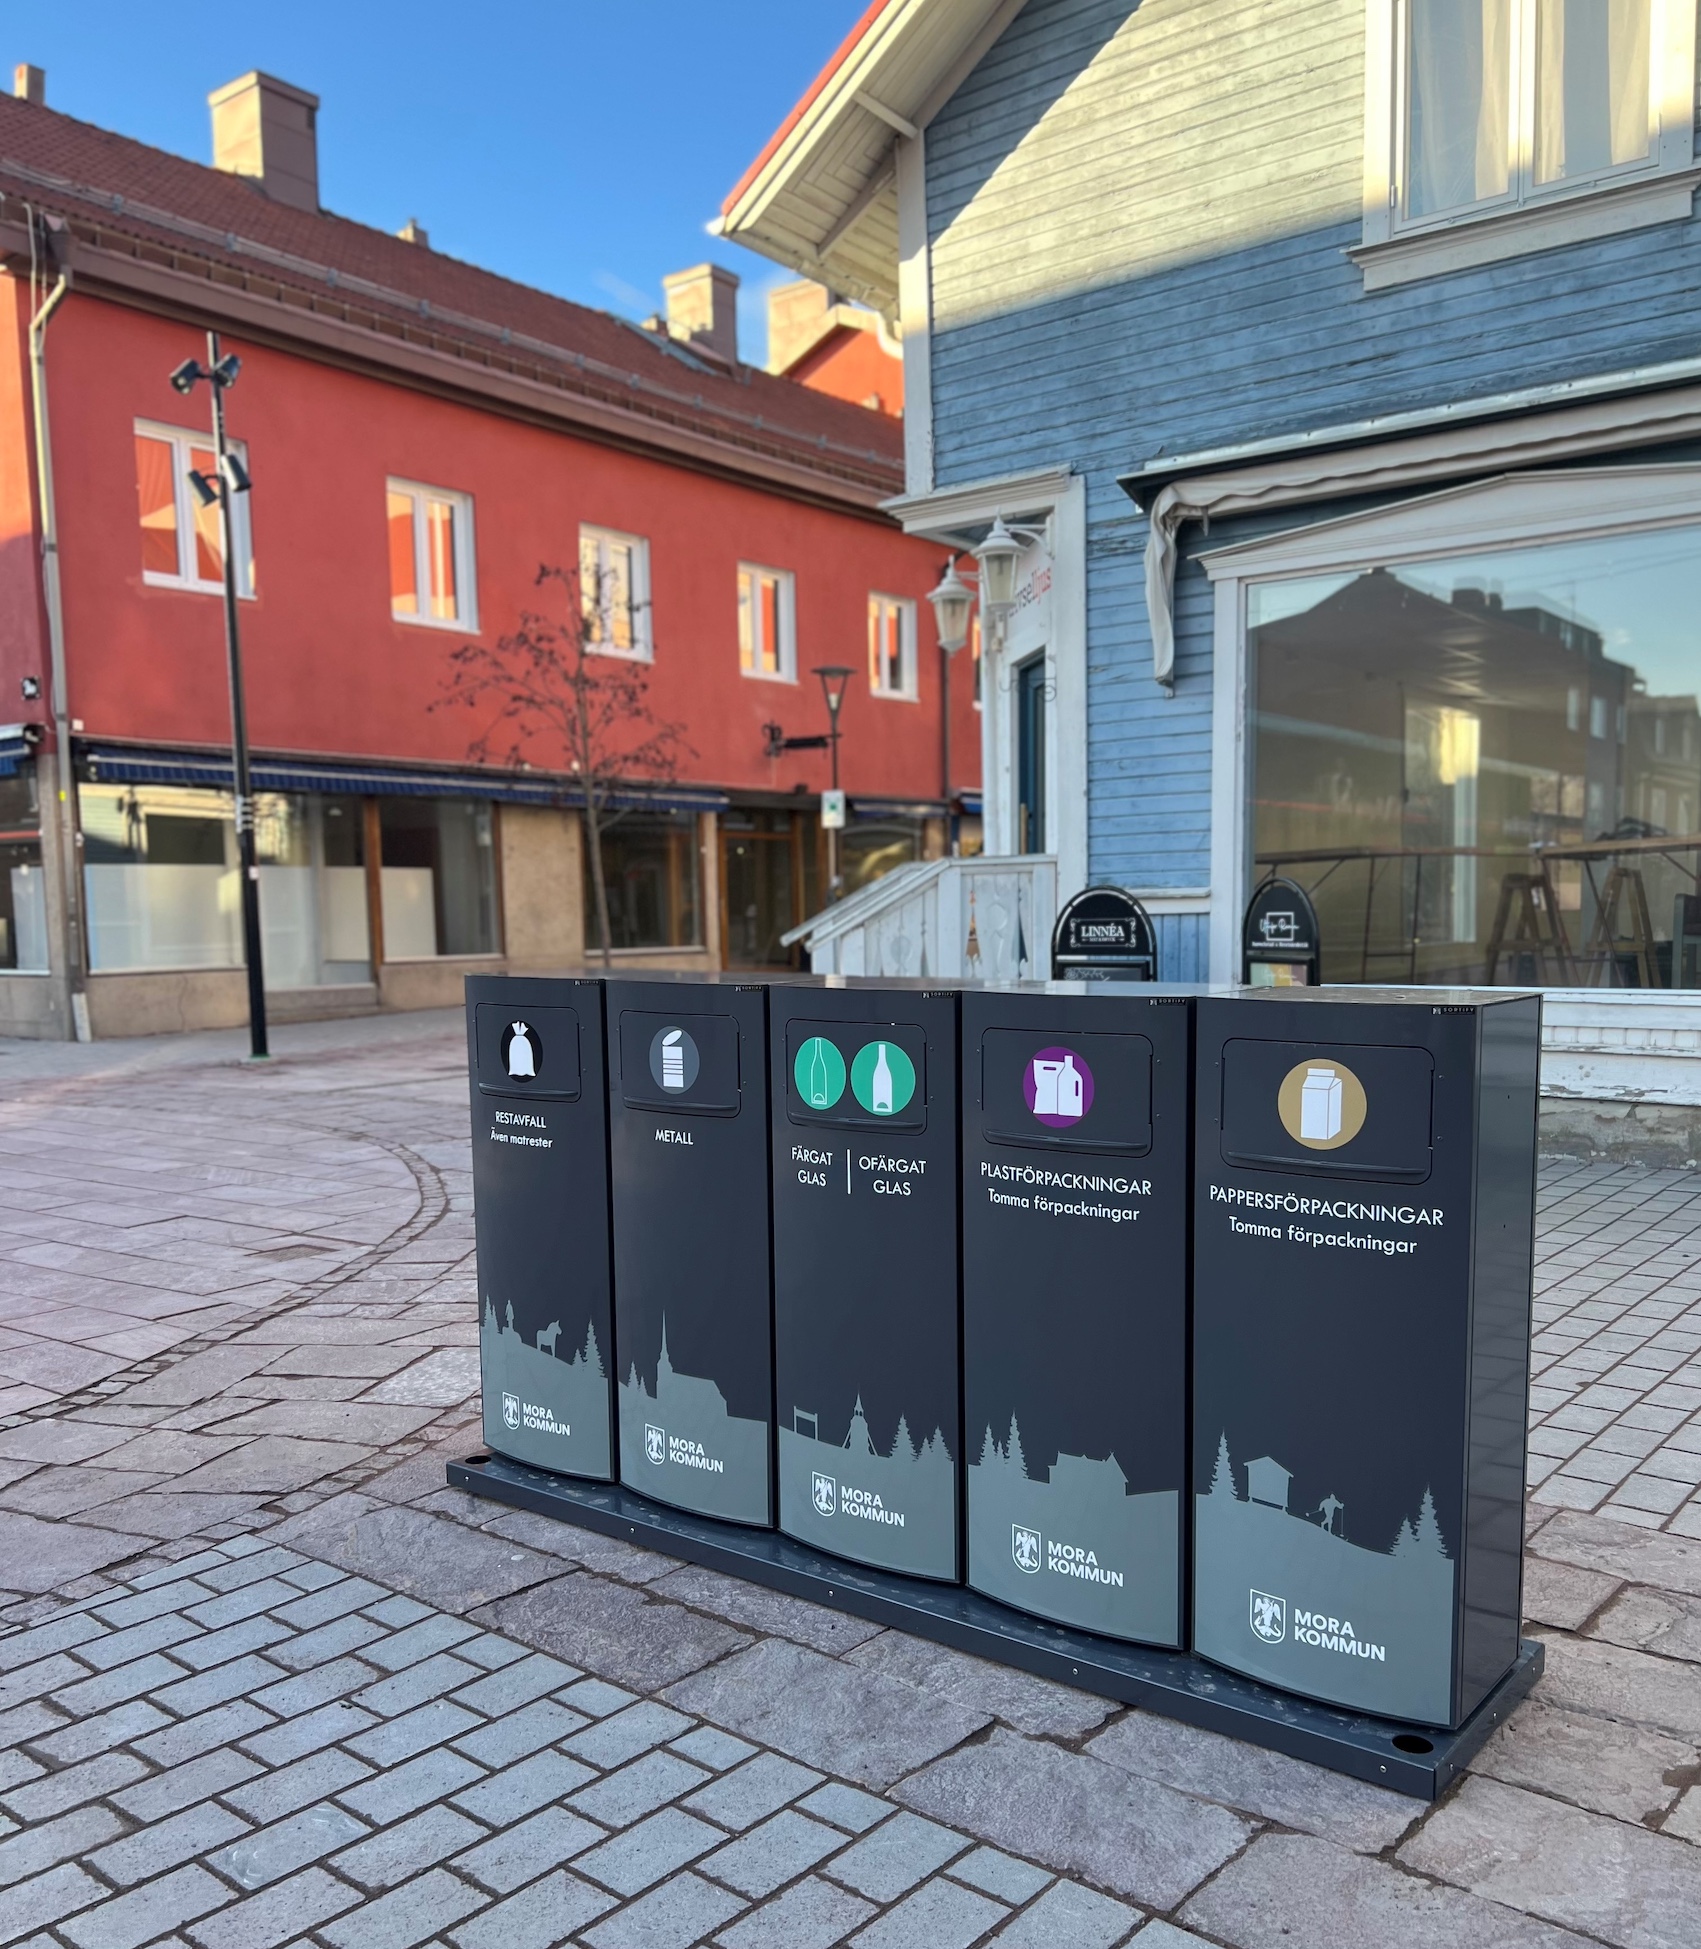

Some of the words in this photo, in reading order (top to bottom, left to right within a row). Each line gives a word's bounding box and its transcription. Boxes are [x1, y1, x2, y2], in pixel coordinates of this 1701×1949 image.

[1081, 923, 1125, 937] LINNÉA
[495, 1111, 547, 1129] RESTAVFALL
[490, 1127, 509, 1144] Även
[510, 1134, 553, 1149] matrester
[655, 1129, 693, 1146] METALL
[791, 1145, 833, 1166] FÄRGAT
[858, 1153, 926, 1175] OFÄRGAT
[797, 1169, 827, 1187] GLAS
[873, 1180, 911, 1196] GLAS
[980, 1161, 1152, 1196] PLASTFÖRPACKNINGAR
[988, 1187, 1030, 1209] Tomma
[1034, 1190, 1140, 1223] förpackningar
[1209, 1185, 1444, 1226] PAPPERSFÖRPACKNINGAR
[1229, 1215, 1282, 1239] Tomma
[1287, 1225, 1418, 1256] förpackningar
[522, 1402, 553, 1420] MORA
[523, 1415, 570, 1436] KOMMUN
[669, 1436, 704, 1455] MORA
[669, 1449, 723, 1473] KOMMUN
[841, 1485, 883, 1508] MORA
[841, 1500, 905, 1527] KOMMUN
[1048, 1540, 1099, 1566] MORA
[1048, 1555, 1124, 1587] KOMMUN
[1294, 1608, 1355, 1638] MORA
[1294, 1625, 1386, 1662] KOMMUN
